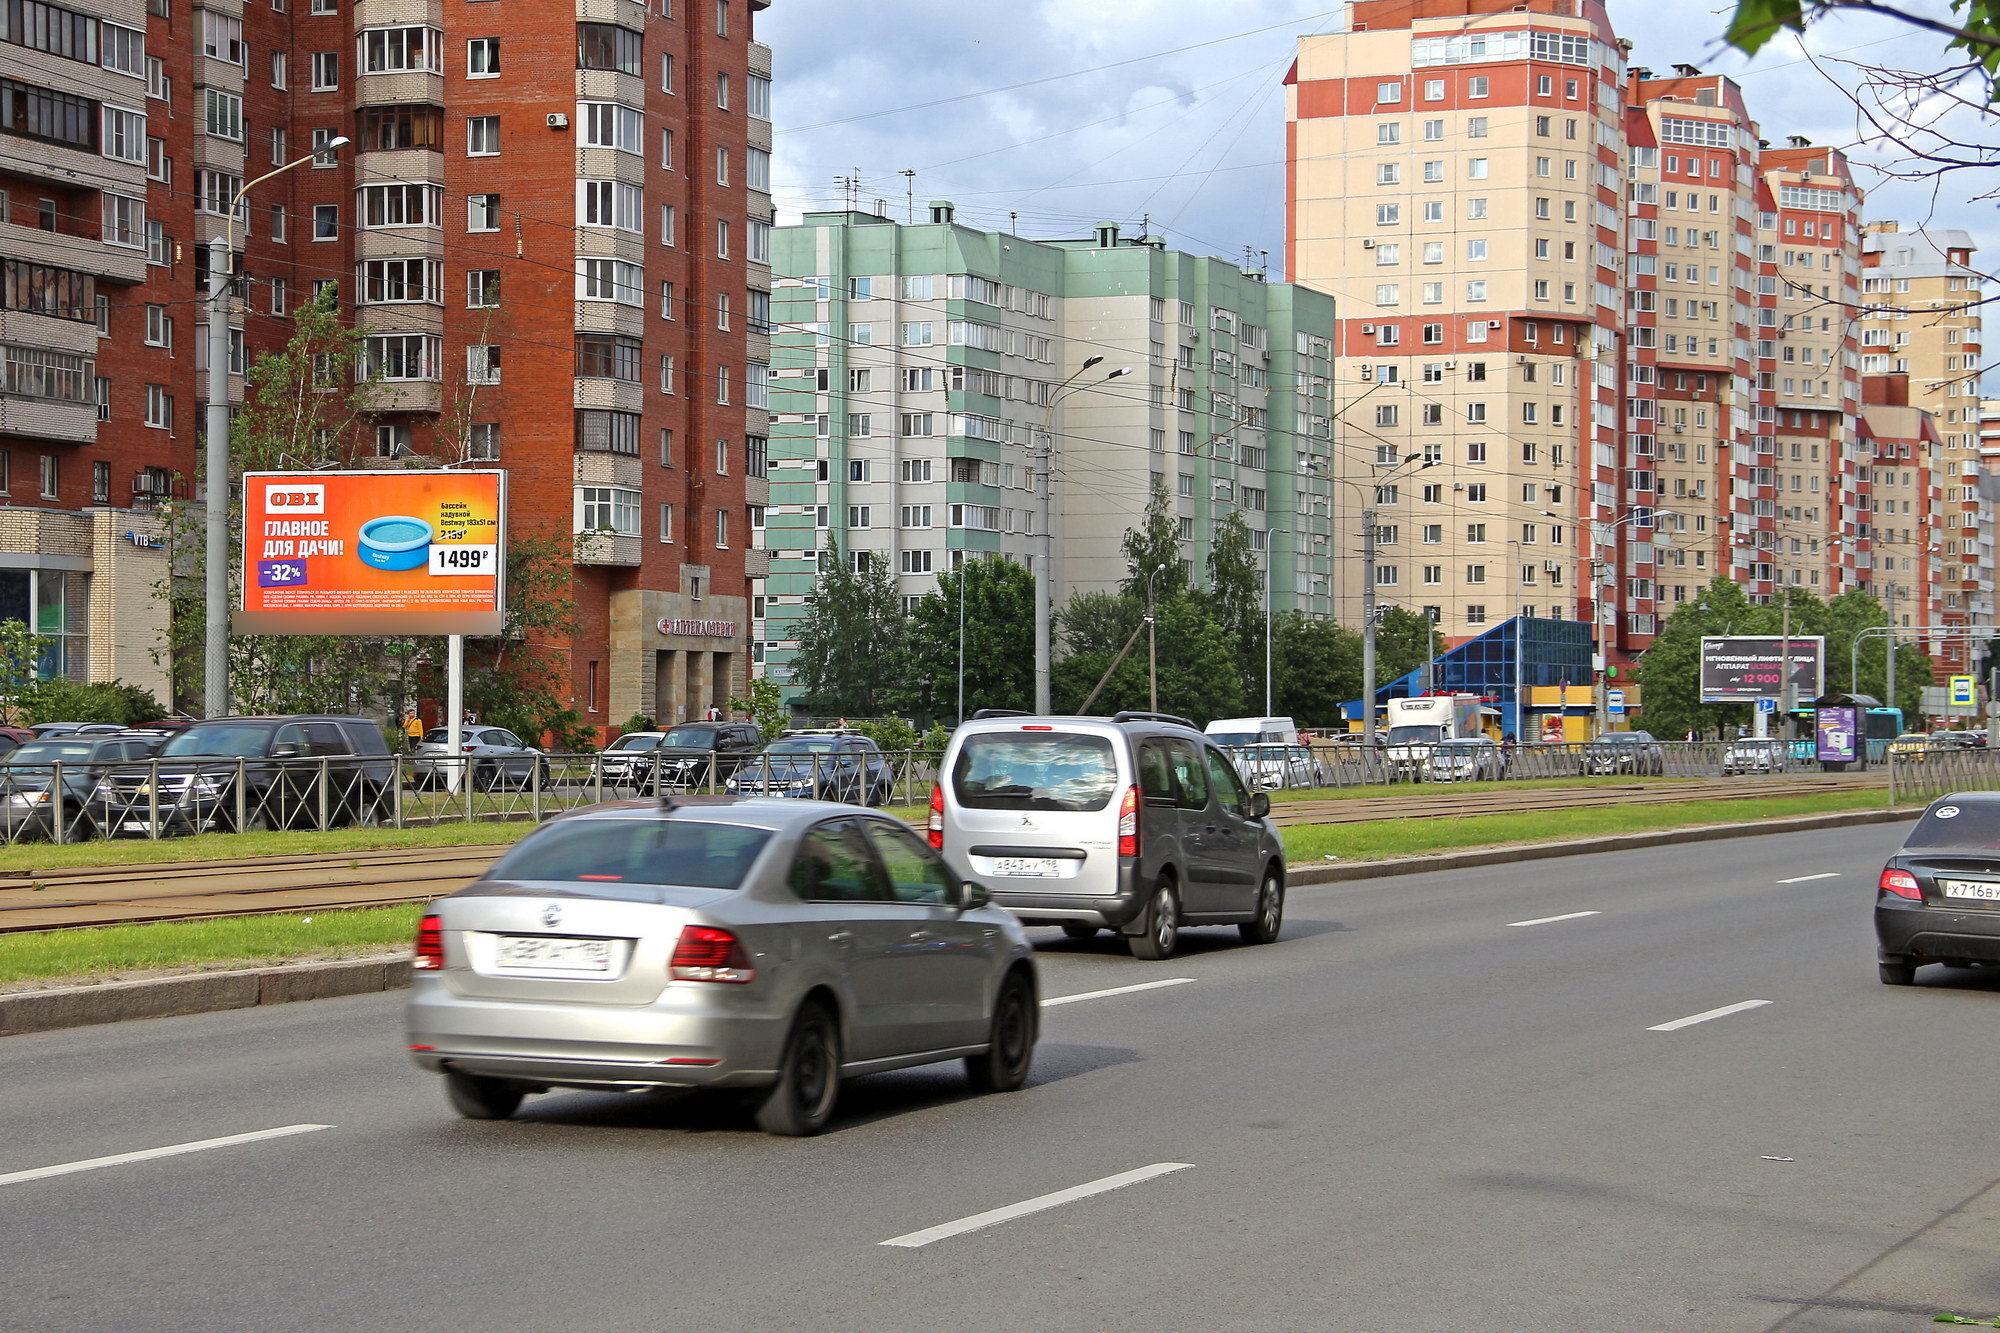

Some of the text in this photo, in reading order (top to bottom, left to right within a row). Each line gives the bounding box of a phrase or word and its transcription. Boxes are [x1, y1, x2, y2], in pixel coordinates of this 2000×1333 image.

[270, 492, 319, 506] OBI
[264, 521, 330, 537] ГЛАВНОЕ
[440, 519, 465, 527] Bestway
[133, 533, 149, 546] VTB
[263, 540, 344, 558] ДЛЯ ДАЧИ!
[263, 564, 301, 581] -32%
[674, 619, 736, 637] АПТЕКА ОЗЕРКИ
[1743, 674, 1754, 683] 12
[1756, 674, 1780, 683] 900
